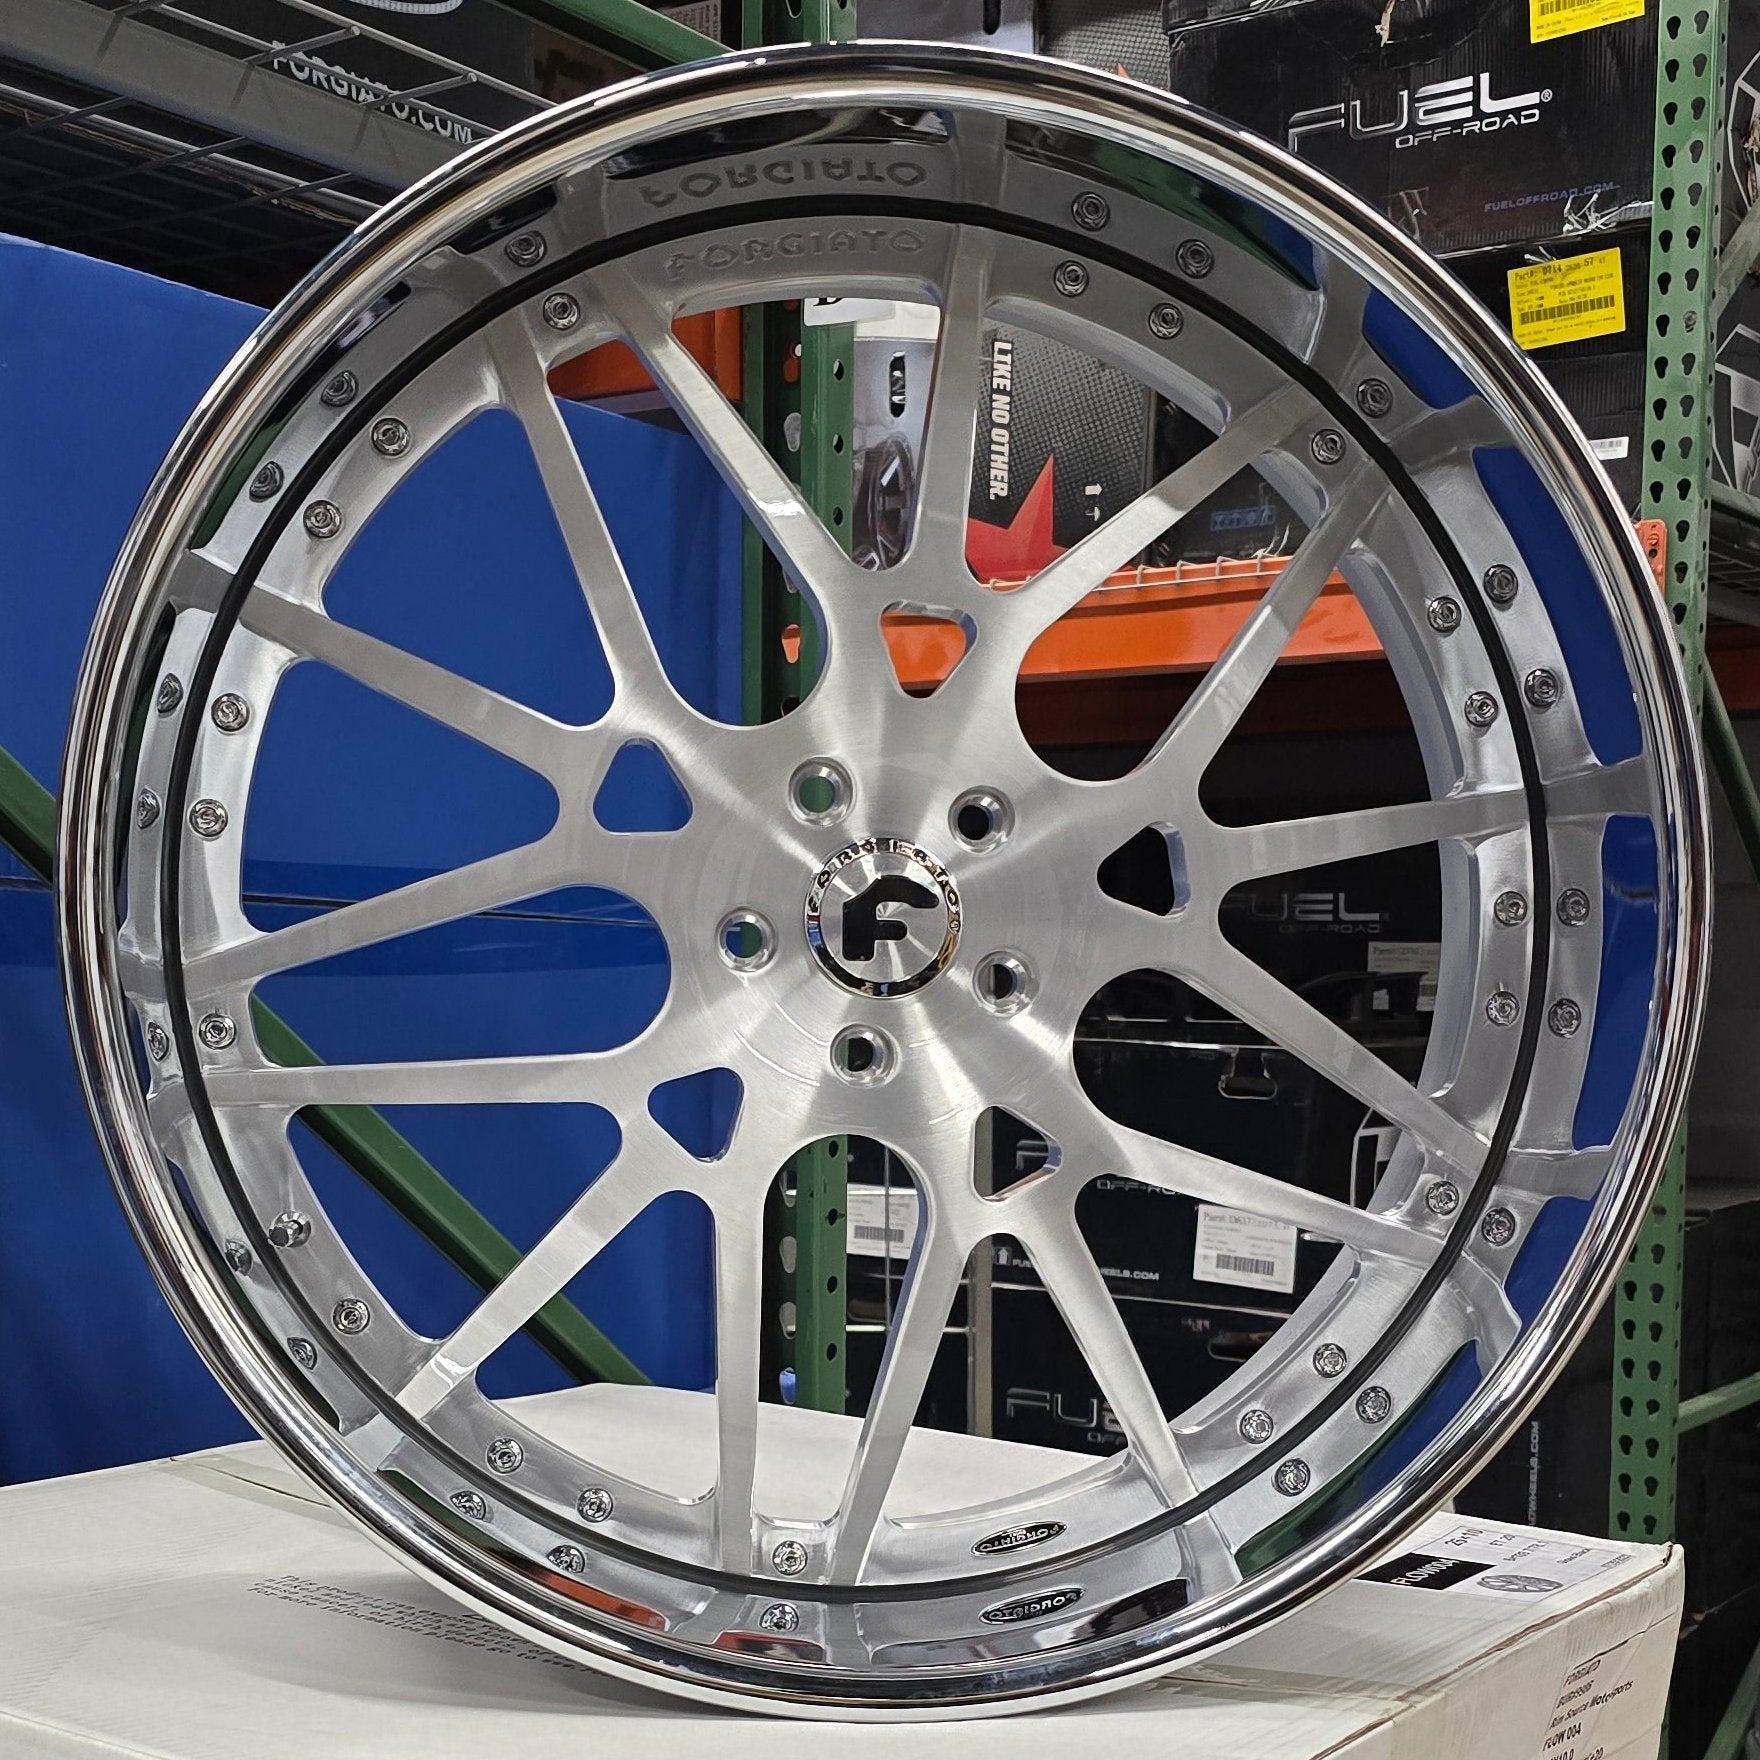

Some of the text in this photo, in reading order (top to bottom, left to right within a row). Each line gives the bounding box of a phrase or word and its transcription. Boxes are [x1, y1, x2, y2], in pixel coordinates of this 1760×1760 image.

[1395, 109, 1540, 149] OFF-ROAD
[663, 229, 924, 281] FORGIATO
[989, 341, 1012, 500] LIKE NO OTHER.
[1542, 1721, 1582, 1752] FLOW 004
